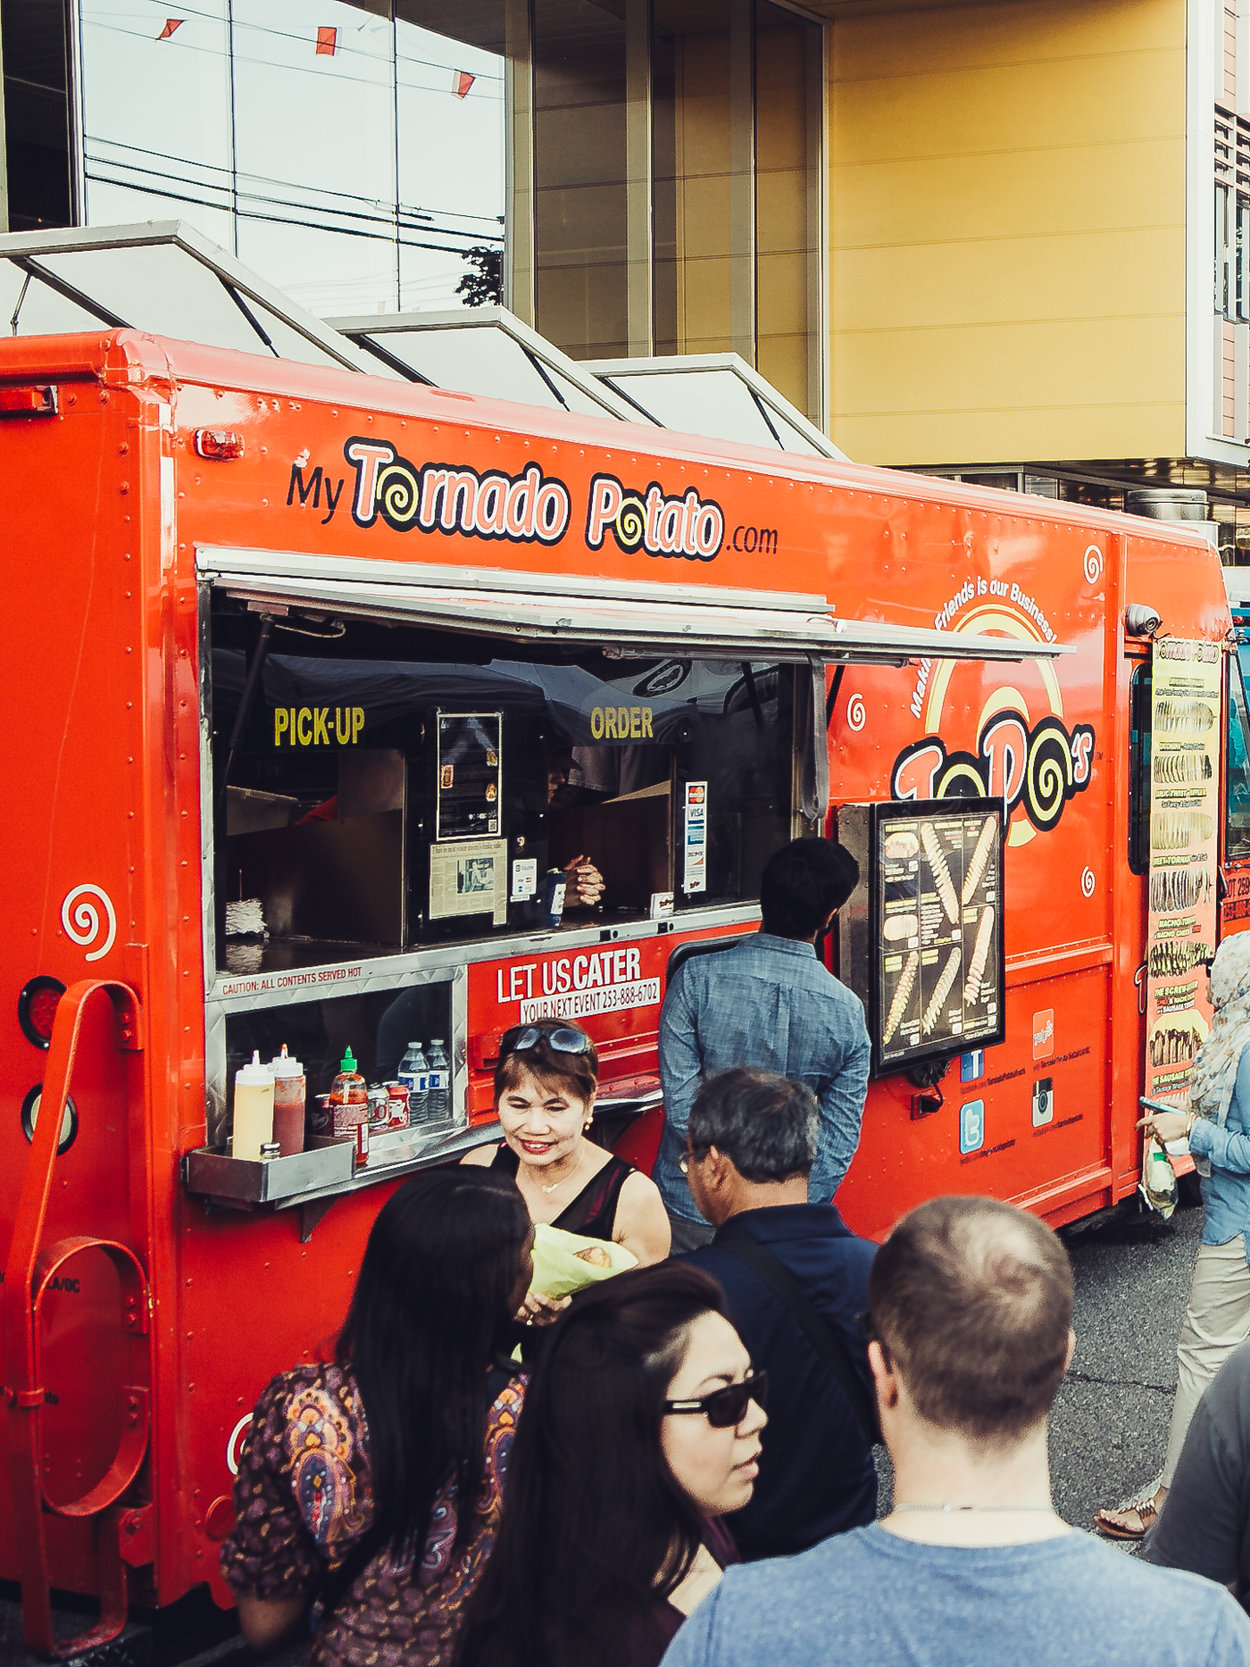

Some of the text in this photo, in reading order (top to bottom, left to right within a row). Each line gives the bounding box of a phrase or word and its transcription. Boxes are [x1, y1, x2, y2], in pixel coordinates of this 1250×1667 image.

[286, 437, 778, 560] My Tornado Potato .com
[934, 582, 975, 631] Friends
[977, 576, 987, 595] is
[989, 579, 1009, 597] our
[1010, 583, 1057, 644] Business!
[274, 707, 365, 746] PICK-UP
[591, 706, 653, 740] ORDER
[690, 808, 704, 817] VISA
[222, 966, 362, 996] CAUTION: ALL CONTENTS SERVED HOT
[497, 947, 641, 1003] LET US CATER
[523, 982, 657, 1024] YOUR NEXT EVENT 253-888-6702
